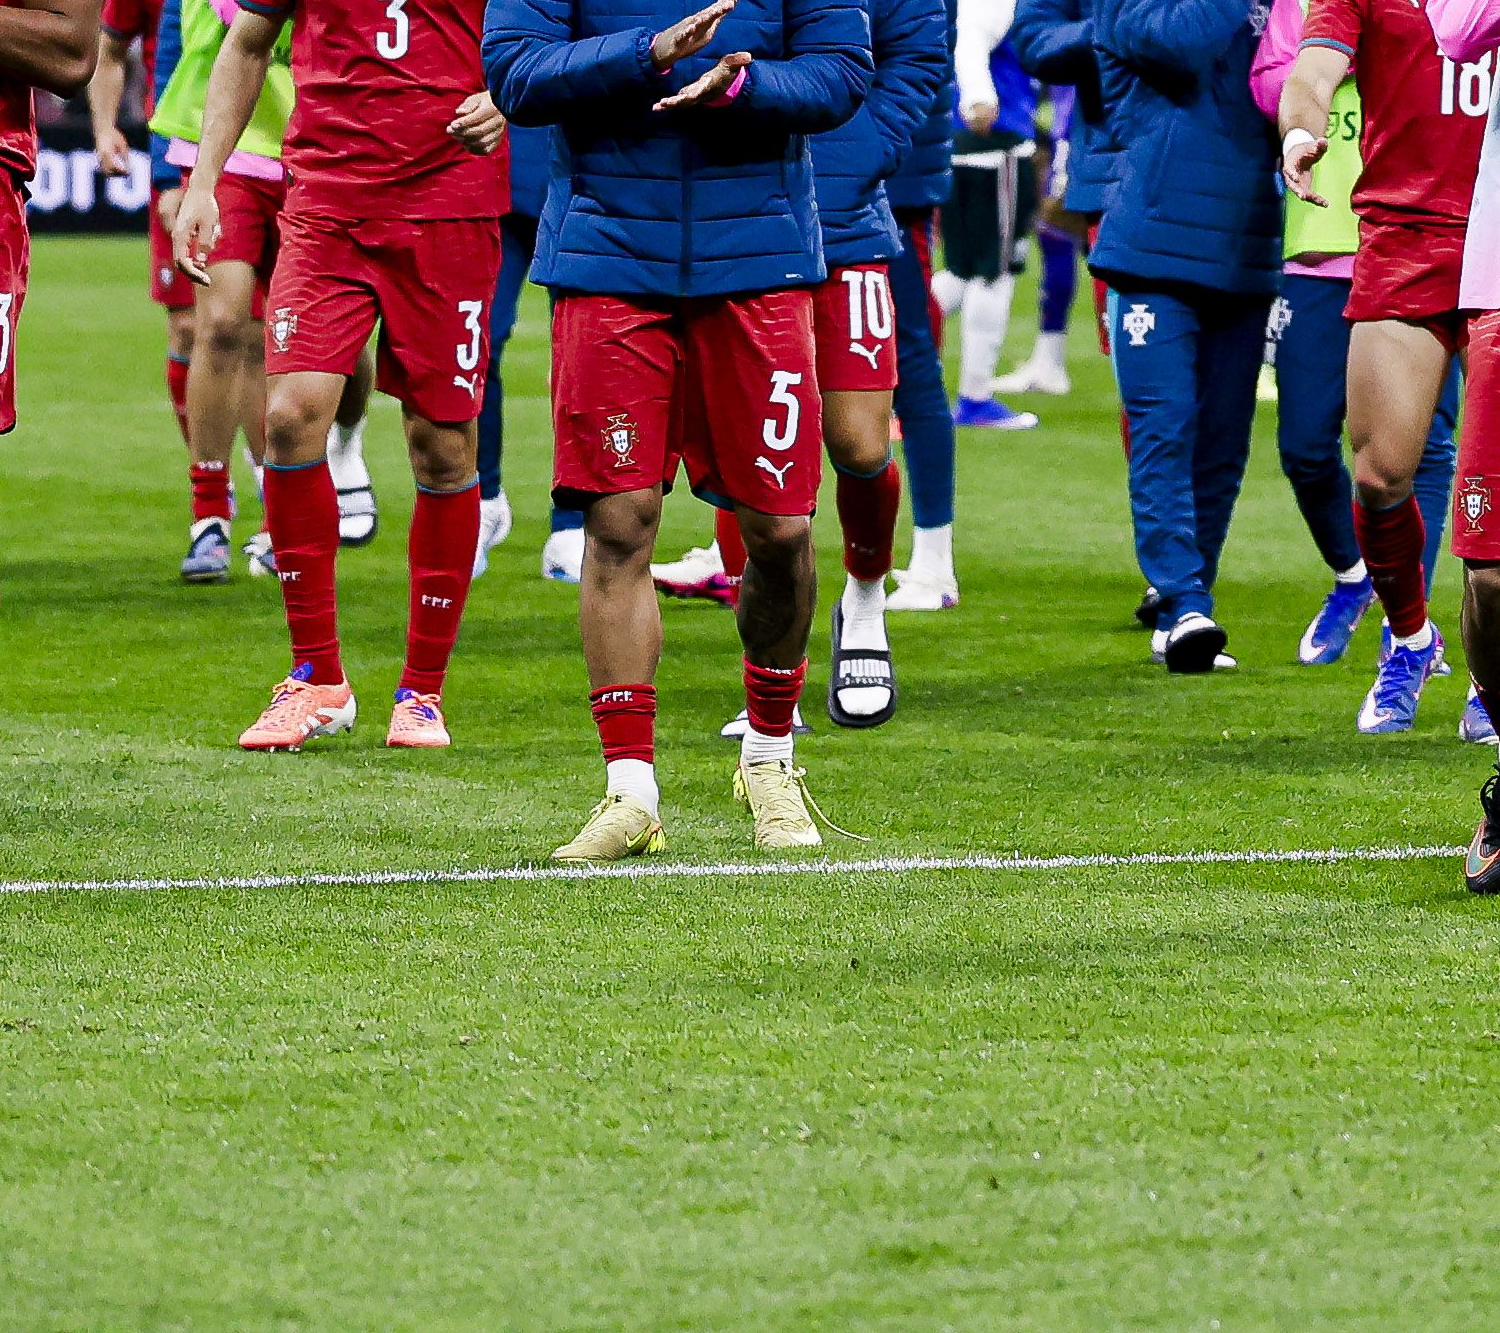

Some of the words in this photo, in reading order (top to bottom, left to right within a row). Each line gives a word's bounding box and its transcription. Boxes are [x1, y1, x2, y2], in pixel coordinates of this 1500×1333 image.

[1436, 47, 1492, 116] 18
[456, 300, 482, 372] 3
[840, 269, 893, 338] 10
[762, 370, 802, 452] 5
